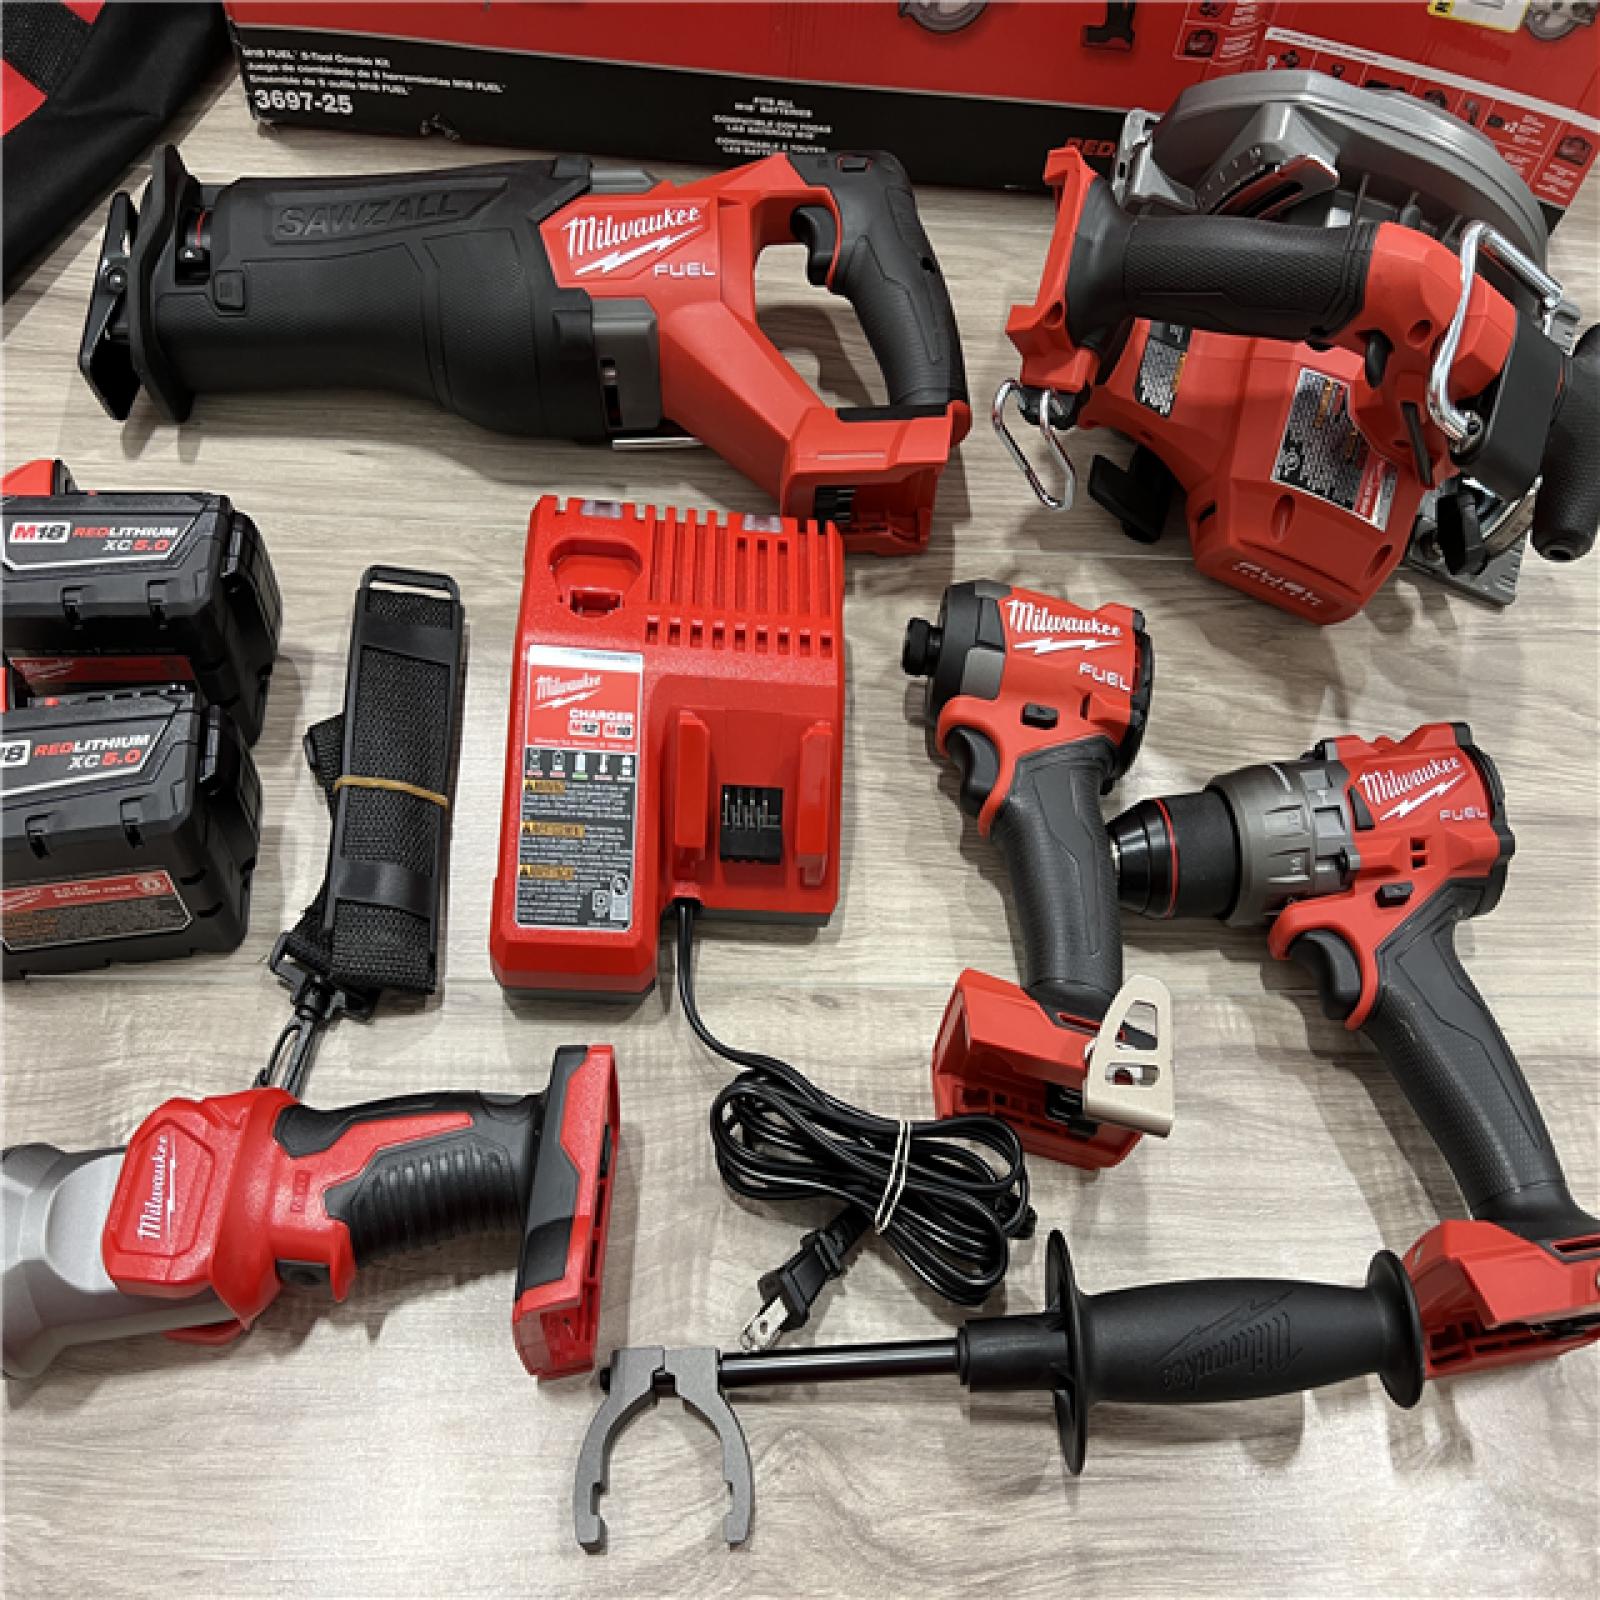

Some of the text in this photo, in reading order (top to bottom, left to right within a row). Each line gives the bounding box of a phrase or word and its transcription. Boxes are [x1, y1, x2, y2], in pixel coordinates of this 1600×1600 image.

[254, 89, 353, 115] 3697-25
[277, 193, 459, 236] SAWZALL
[562, 206, 701, 261] Milwaukee
[654, 261, 716, 279] FUEL
[14, 523, 67, 540] M18
[1005, 599, 1123, 637] Milwaukee
[1079, 661, 1131, 693] FUEL
[569, 707, 633, 723] CHARGER
[1358, 756, 1462, 805] Milwaukee
[1438, 805, 1488, 822] FUEL
[137, 1135, 168, 1240] Milwaukee
[1160, 1310, 1304, 1393] Milwaukee
